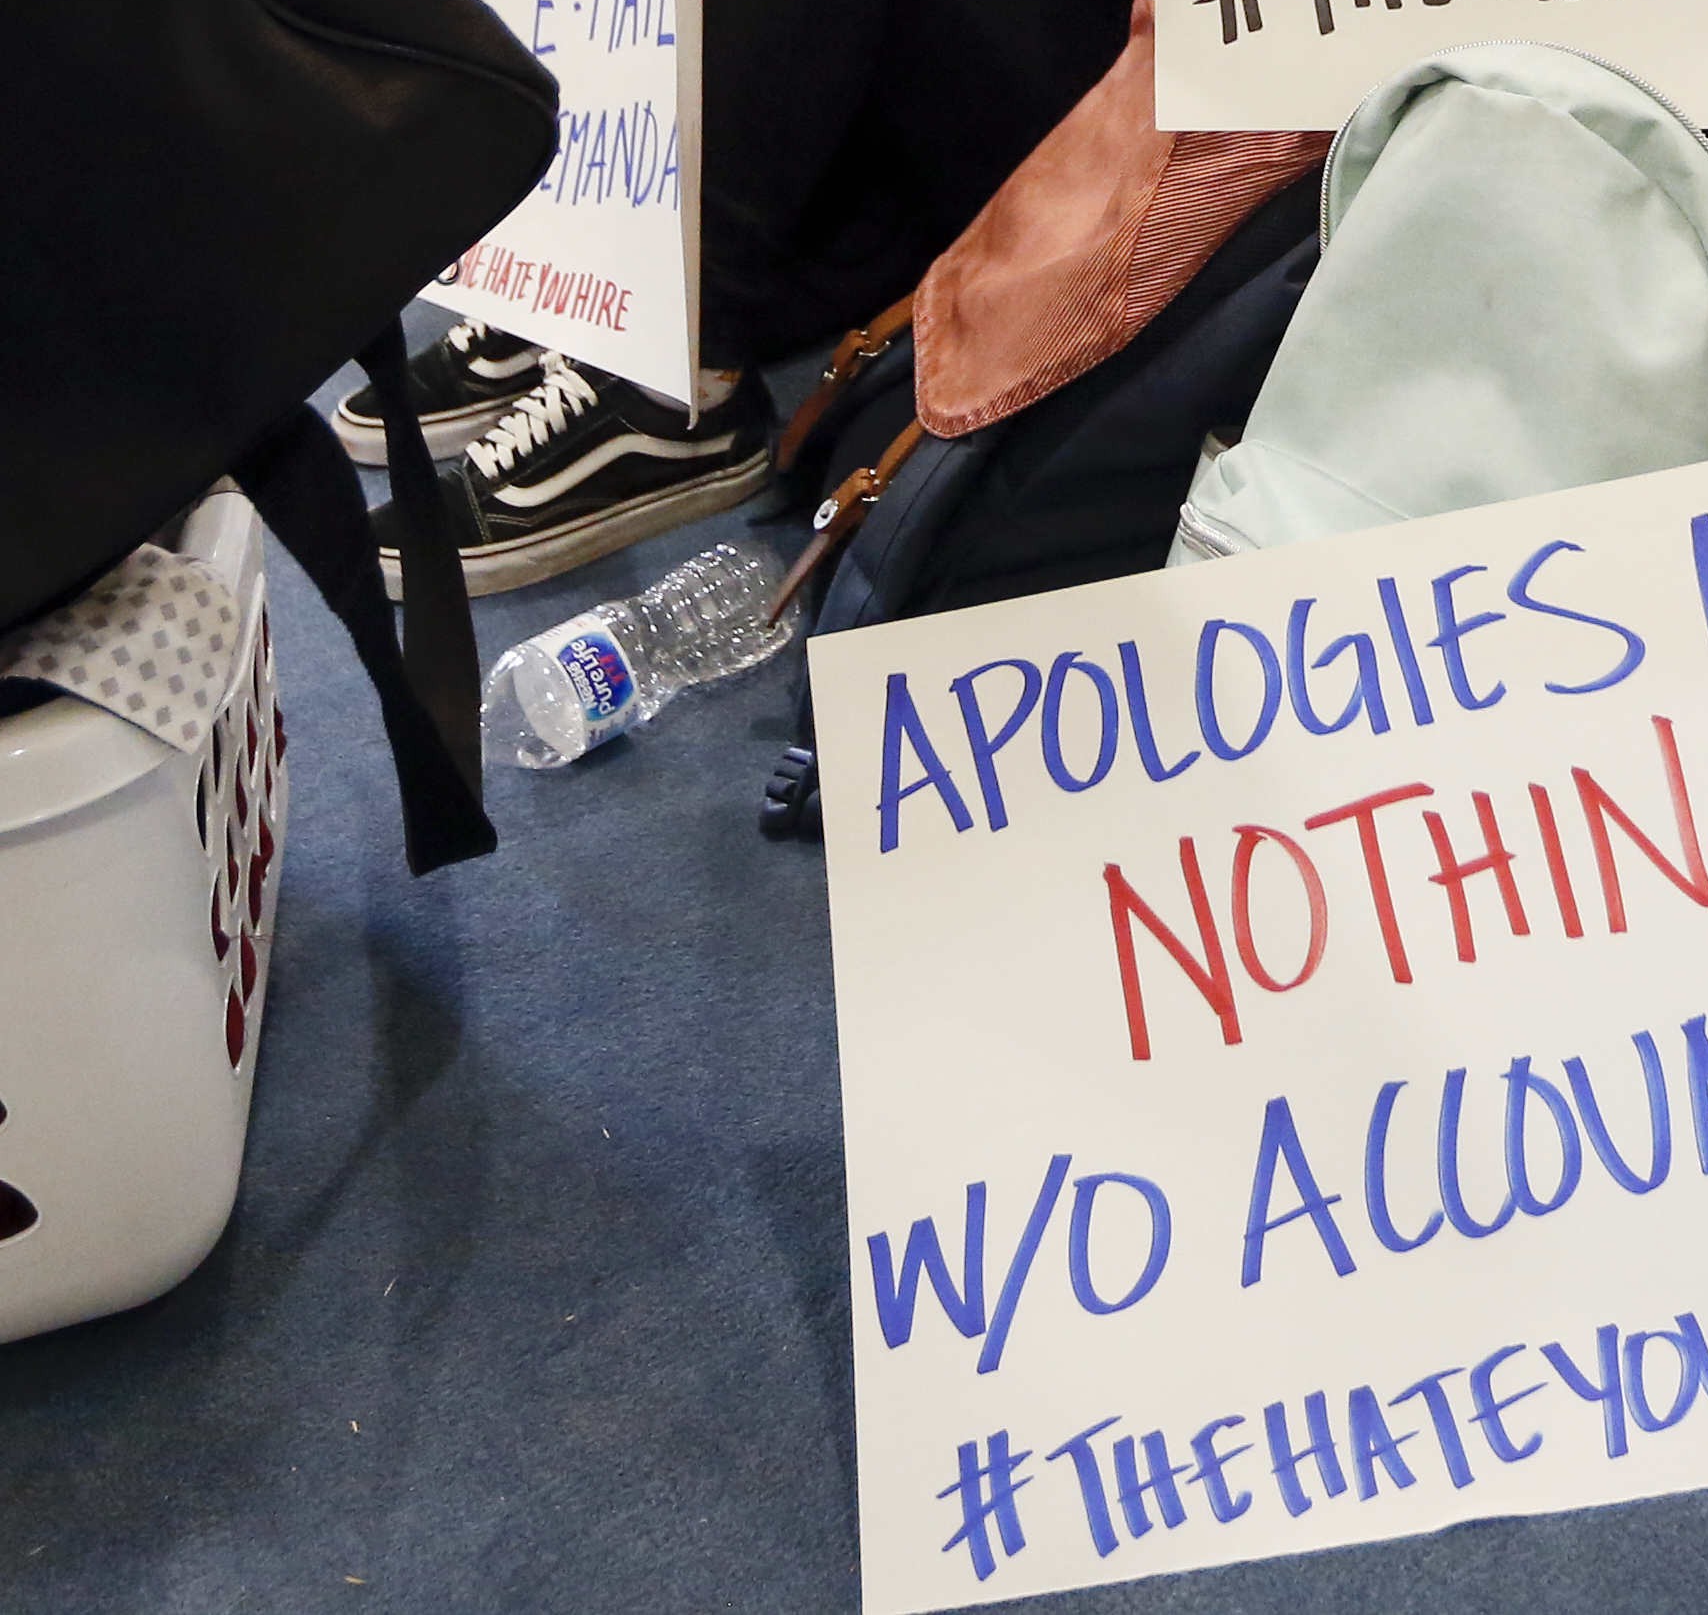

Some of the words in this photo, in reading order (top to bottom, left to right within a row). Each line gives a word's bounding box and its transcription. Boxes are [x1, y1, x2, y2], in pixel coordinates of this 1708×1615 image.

[570, 639, 601, 670] Life
[590, 668, 615, 715] Pure
[879, 541, 1646, 852] APOLOGIES
[868, 1155, 1171, 1374] W/O
